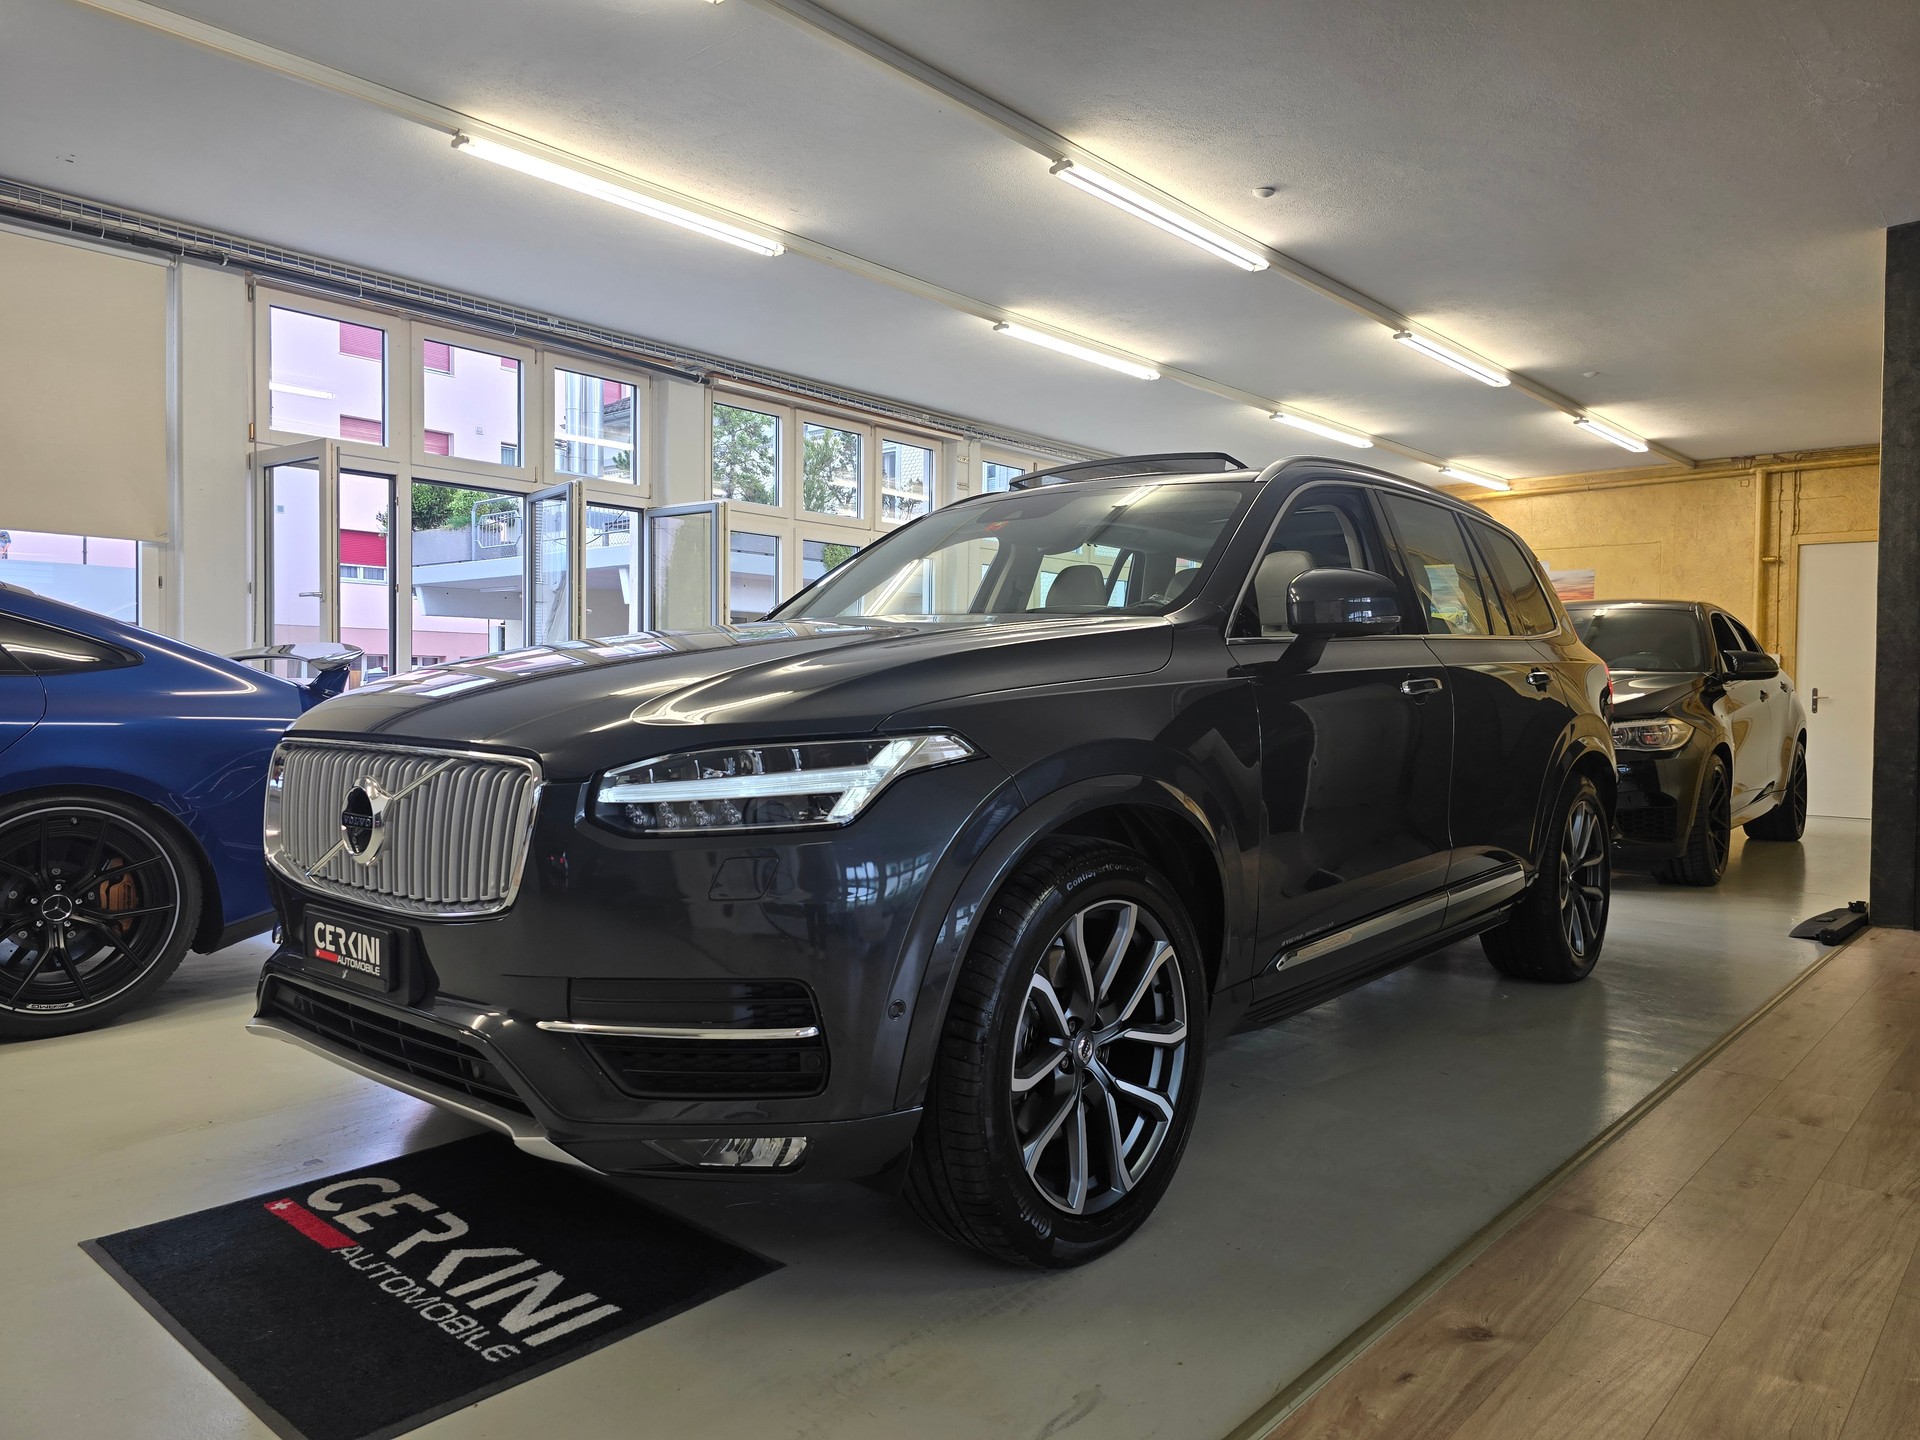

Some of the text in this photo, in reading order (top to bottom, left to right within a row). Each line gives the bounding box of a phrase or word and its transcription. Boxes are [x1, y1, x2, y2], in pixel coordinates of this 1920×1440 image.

[343, 815, 372, 827] VOLVO
[314, 921, 380, 965] CERKINI
[337, 954, 380, 976] AUTOMOBILE
[306, 1177, 622, 1348] CERKINI
[331, 1245, 521, 1362] AUTOMOBILE
